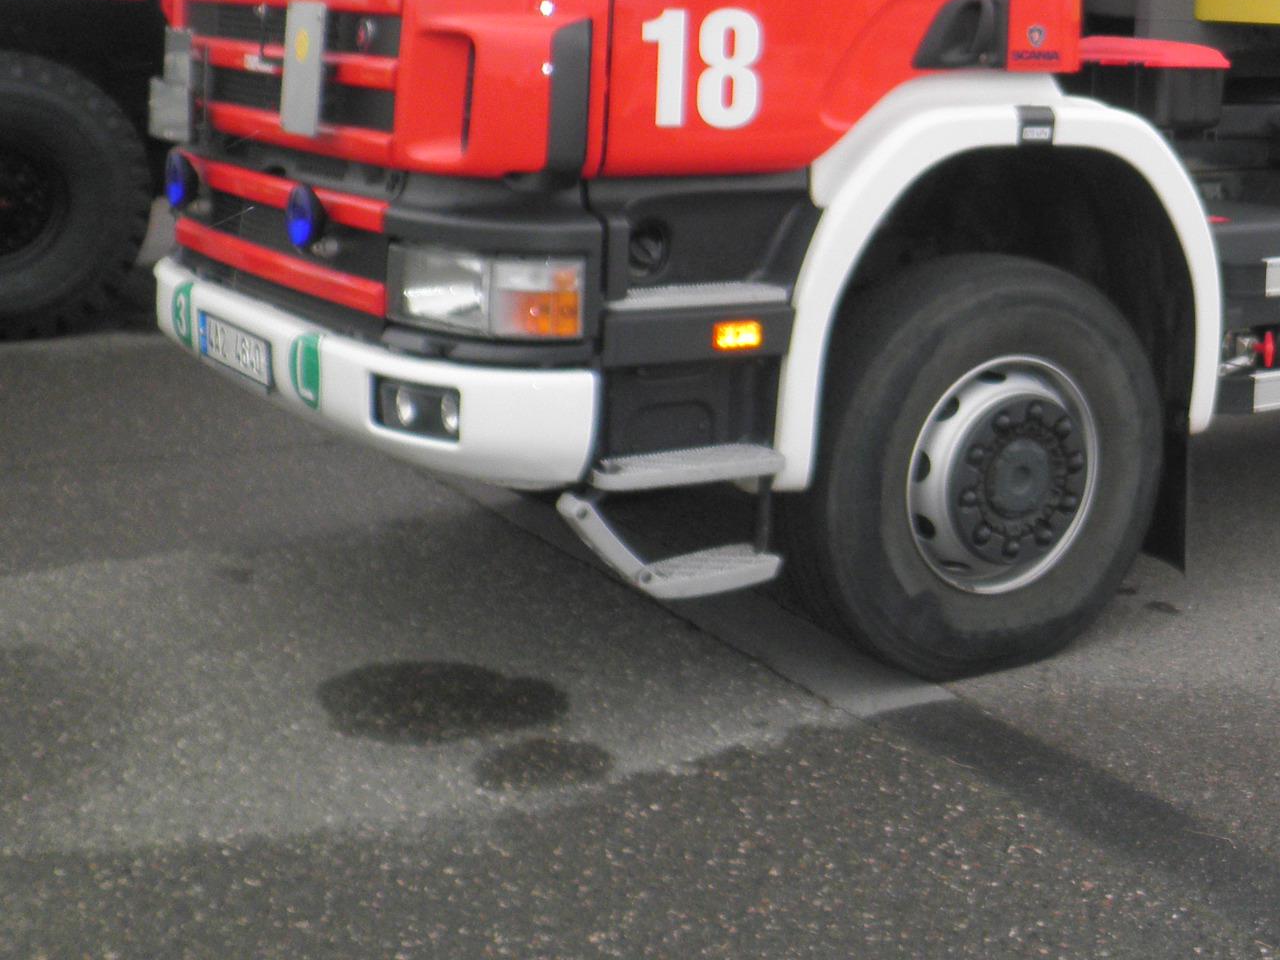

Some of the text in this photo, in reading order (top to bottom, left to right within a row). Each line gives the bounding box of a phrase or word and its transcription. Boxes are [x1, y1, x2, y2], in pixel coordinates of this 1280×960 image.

[641, 7, 763, 130] 18
[176, 293, 187, 337] 3
[297, 338, 315, 400] L
